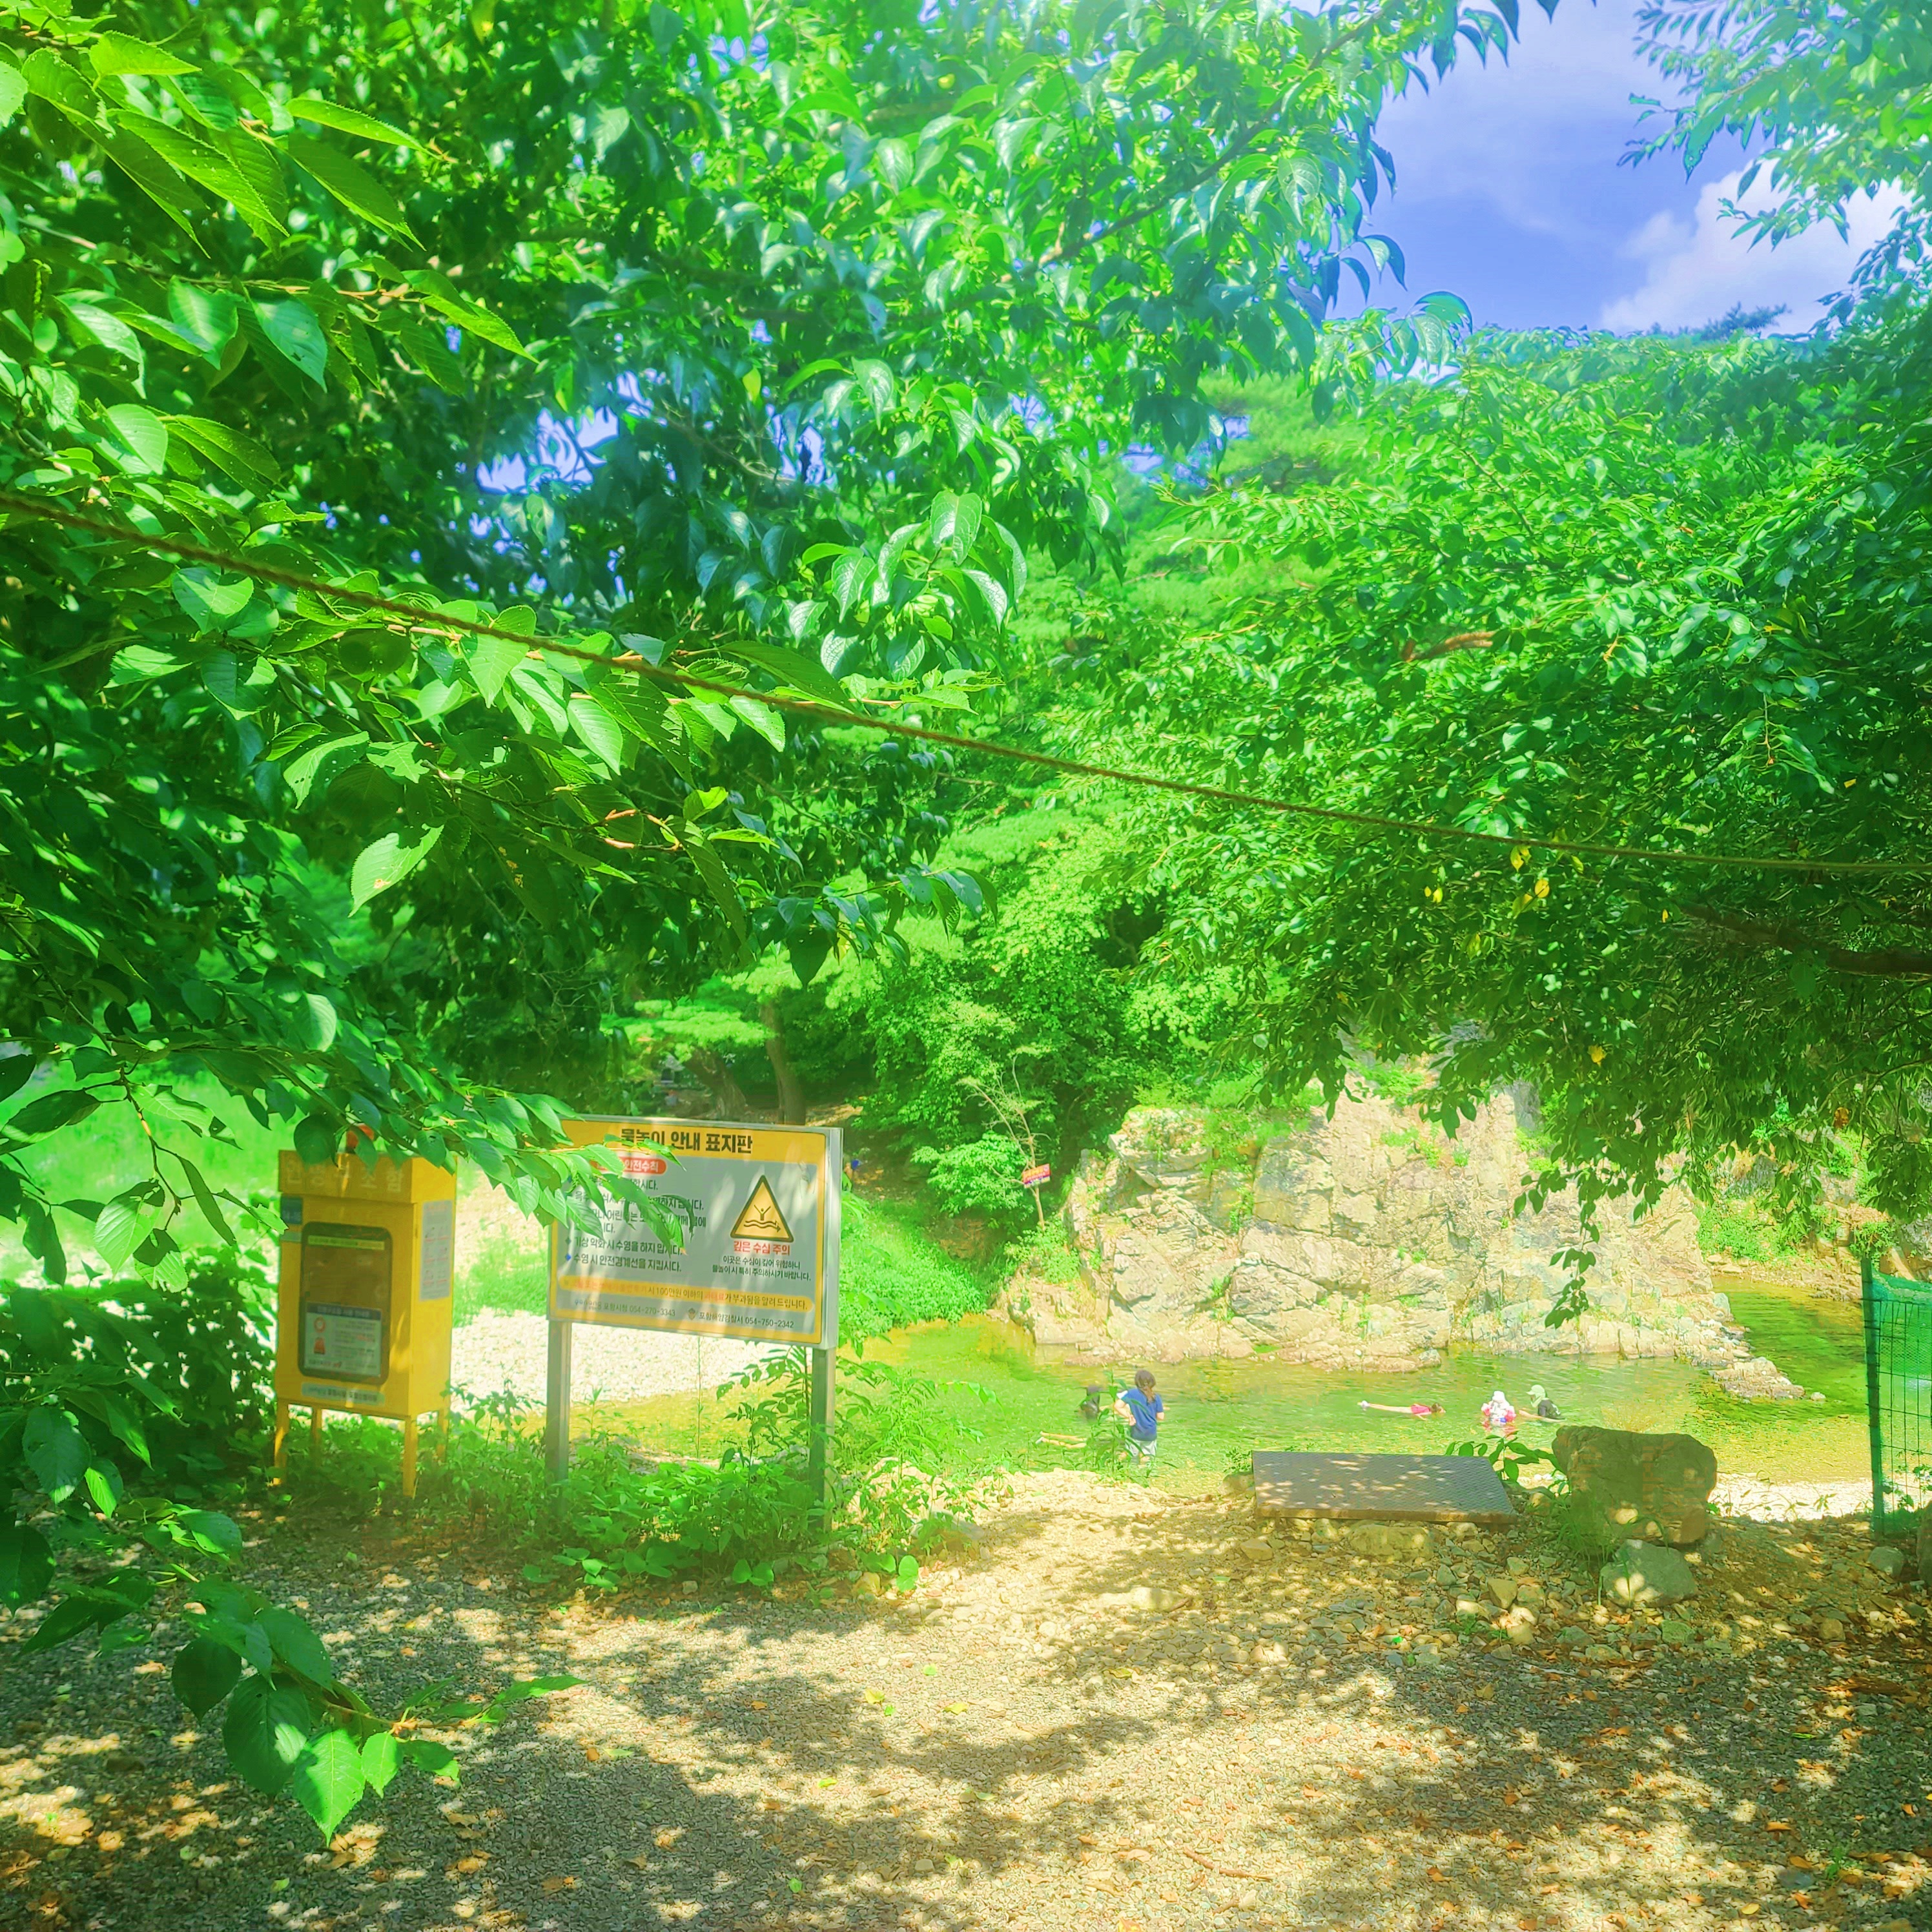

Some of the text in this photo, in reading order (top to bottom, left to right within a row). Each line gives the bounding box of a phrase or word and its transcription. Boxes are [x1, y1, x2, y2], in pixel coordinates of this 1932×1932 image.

[671, 1131, 700, 1151] 안내
[706, 1133, 752, 1154] 표지판
[575, 1237, 589, 1248] 기상
[590, 1238, 605, 1249] 악화
[607, 1240, 614, 1250] 시
[616, 1241, 638, 1252] 수영을
[640, 1242, 655, 1253] 하지
[734, 1240, 790, 1255] 깊은 수심 주의
[574, 1254, 682, 1272] 수영 시 안전경계선을 지킵시다.
[723, 1255, 800, 1269] 이곳은 수심이 깊어 위험하니
[712, 1264, 811, 1281] 물놀이 시 특히 주의하시기 바랍니다.
[683, 1289, 703, 1300] 이하의
[732, 1293, 761, 1305] 부과됨을
[761, 1296, 776, 1307] 알려
[777, 1299, 808, 1310] 드립니다.
[629, 1304, 676, 1317] 054-270-3343
[745, 1316, 794, 1328] 054-750-2342
